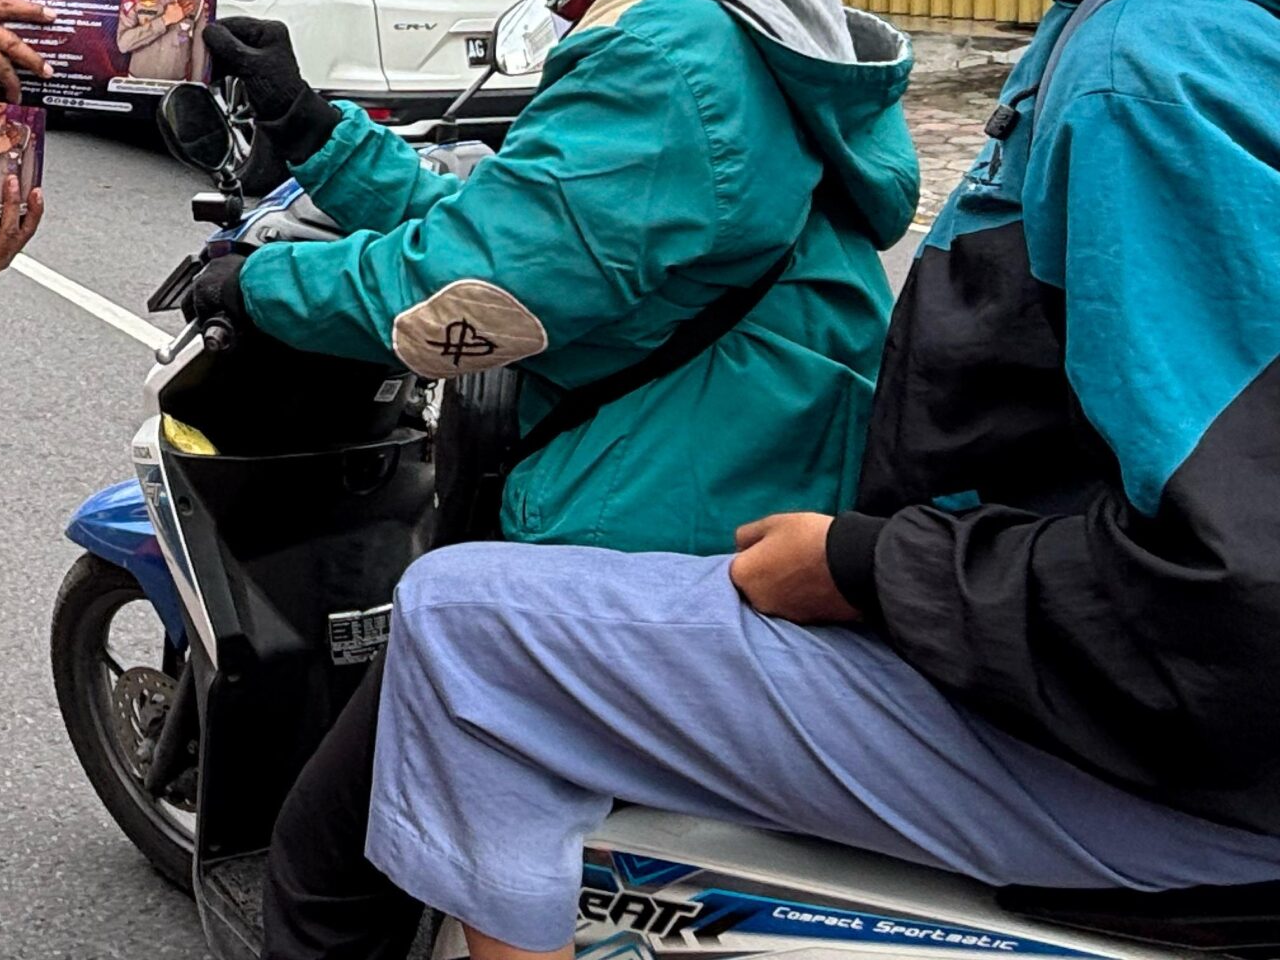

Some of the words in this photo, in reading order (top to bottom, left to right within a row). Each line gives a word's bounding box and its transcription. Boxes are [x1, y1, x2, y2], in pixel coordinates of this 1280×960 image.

[393, 22, 438, 31] CR-V
[467, 39, 485, 58] AG
[577, 888, 704, 939] eAT
[772, 905, 864, 931] Compact
[872, 920, 1020, 952] Sportmatic
